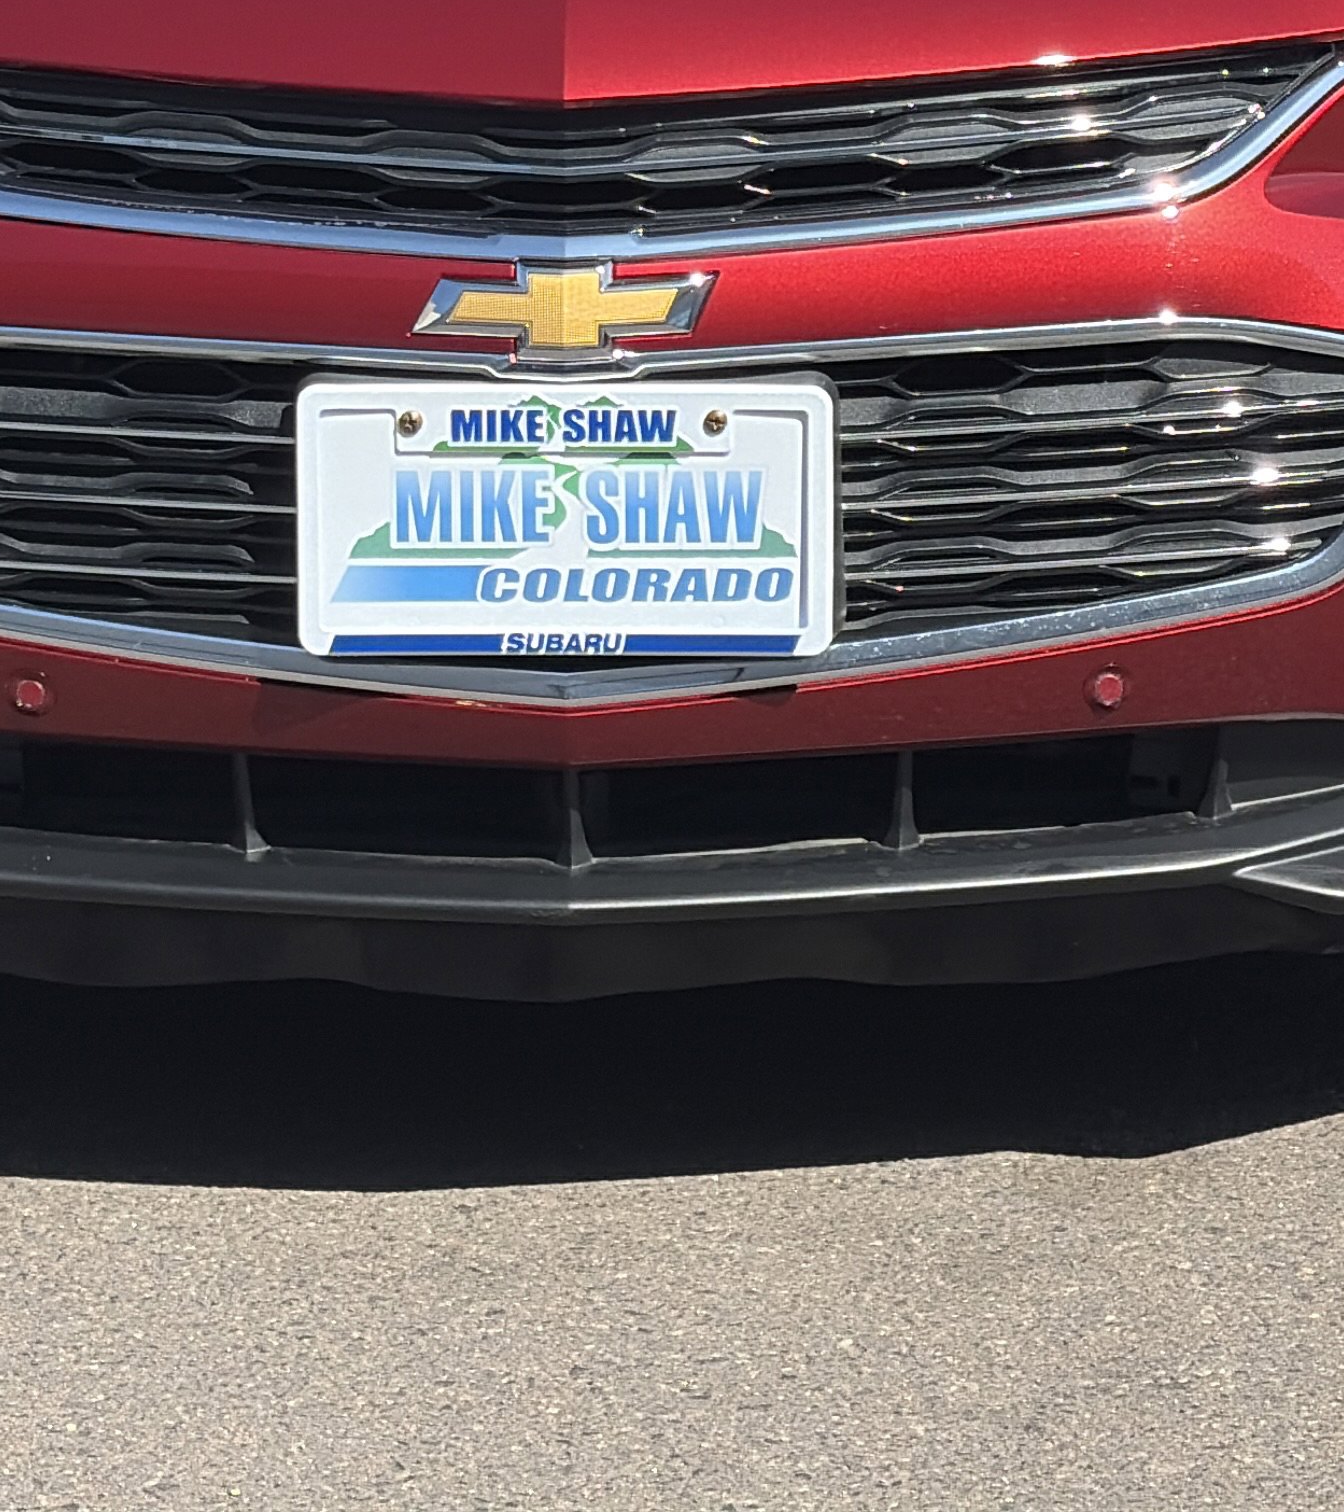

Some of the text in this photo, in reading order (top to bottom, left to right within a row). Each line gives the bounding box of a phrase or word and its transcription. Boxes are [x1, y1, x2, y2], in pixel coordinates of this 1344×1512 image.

[451, 408, 677, 443] MIKE SHAW
[395, 469, 764, 544] MIKE SHAW
[479, 567, 794, 603] COLORADO
[505, 632, 624, 654] SUBARU
